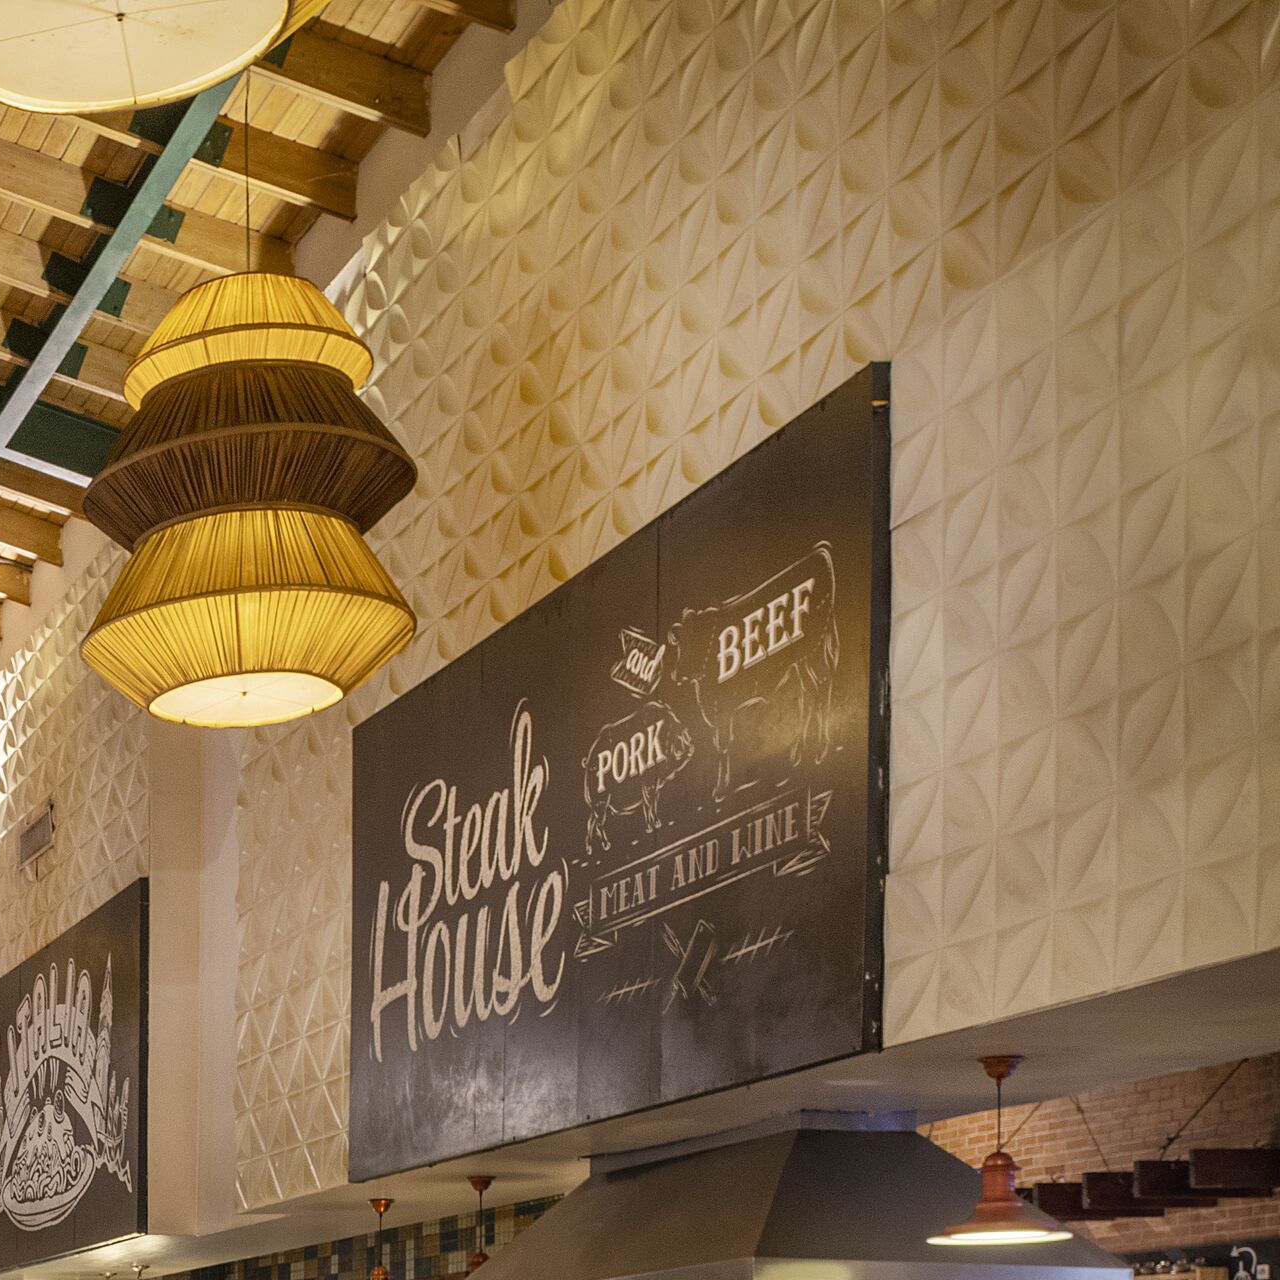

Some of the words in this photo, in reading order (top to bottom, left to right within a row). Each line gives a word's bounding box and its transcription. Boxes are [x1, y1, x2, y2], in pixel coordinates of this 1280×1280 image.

[626, 643, 666, 684] and
[716, 577, 817, 685] BEEF
[403, 706, 549, 928] Steak
[596, 720, 667, 794] PORK
[599, 868, 661, 922] MEAT
[670, 840, 721, 890] AND
[730, 800, 800, 865] WINE
[370, 866, 566, 1062] House
[6, 957, 92, 1098] ITALIA
